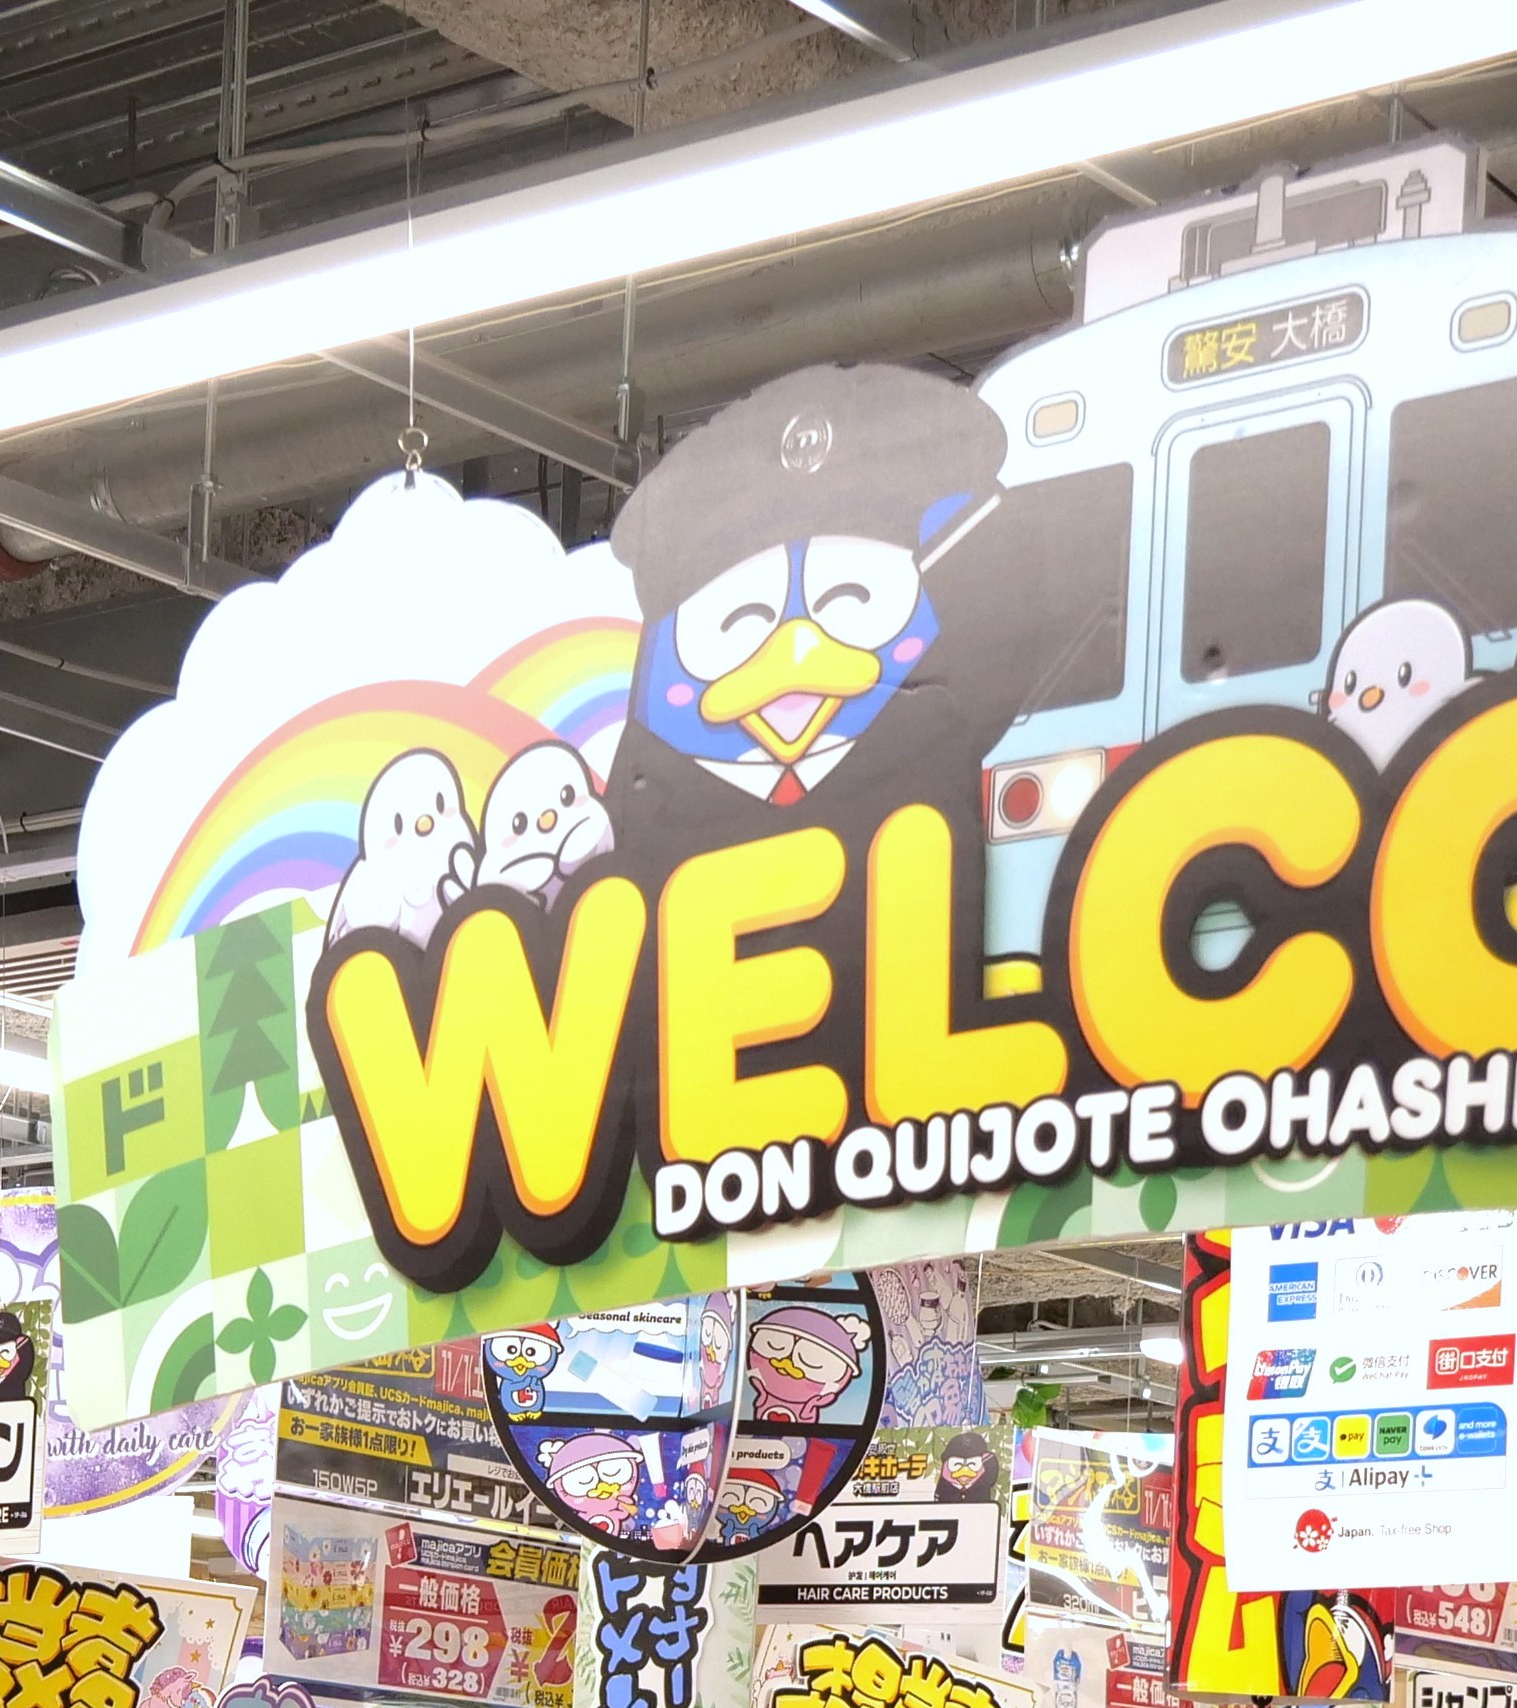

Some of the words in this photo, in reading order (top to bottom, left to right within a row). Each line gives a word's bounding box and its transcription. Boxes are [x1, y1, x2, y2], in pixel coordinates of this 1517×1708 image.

[1271, 300, 1347, 358] 大橋
[654, 1138, 812, 1238] DON
[836, 1086, 1175, 1209] QUIJOTE
[736, 1449, 785, 1462] products
[1349, 1469, 1410, 1489] Alipay
[796, 1520, 958, 1567] ヘアケア
[797, 1587, 829, 1601] HAIR
[832, 1587, 863, 1601] CARE
[867, 1586, 948, 1601] PRODUCTS
